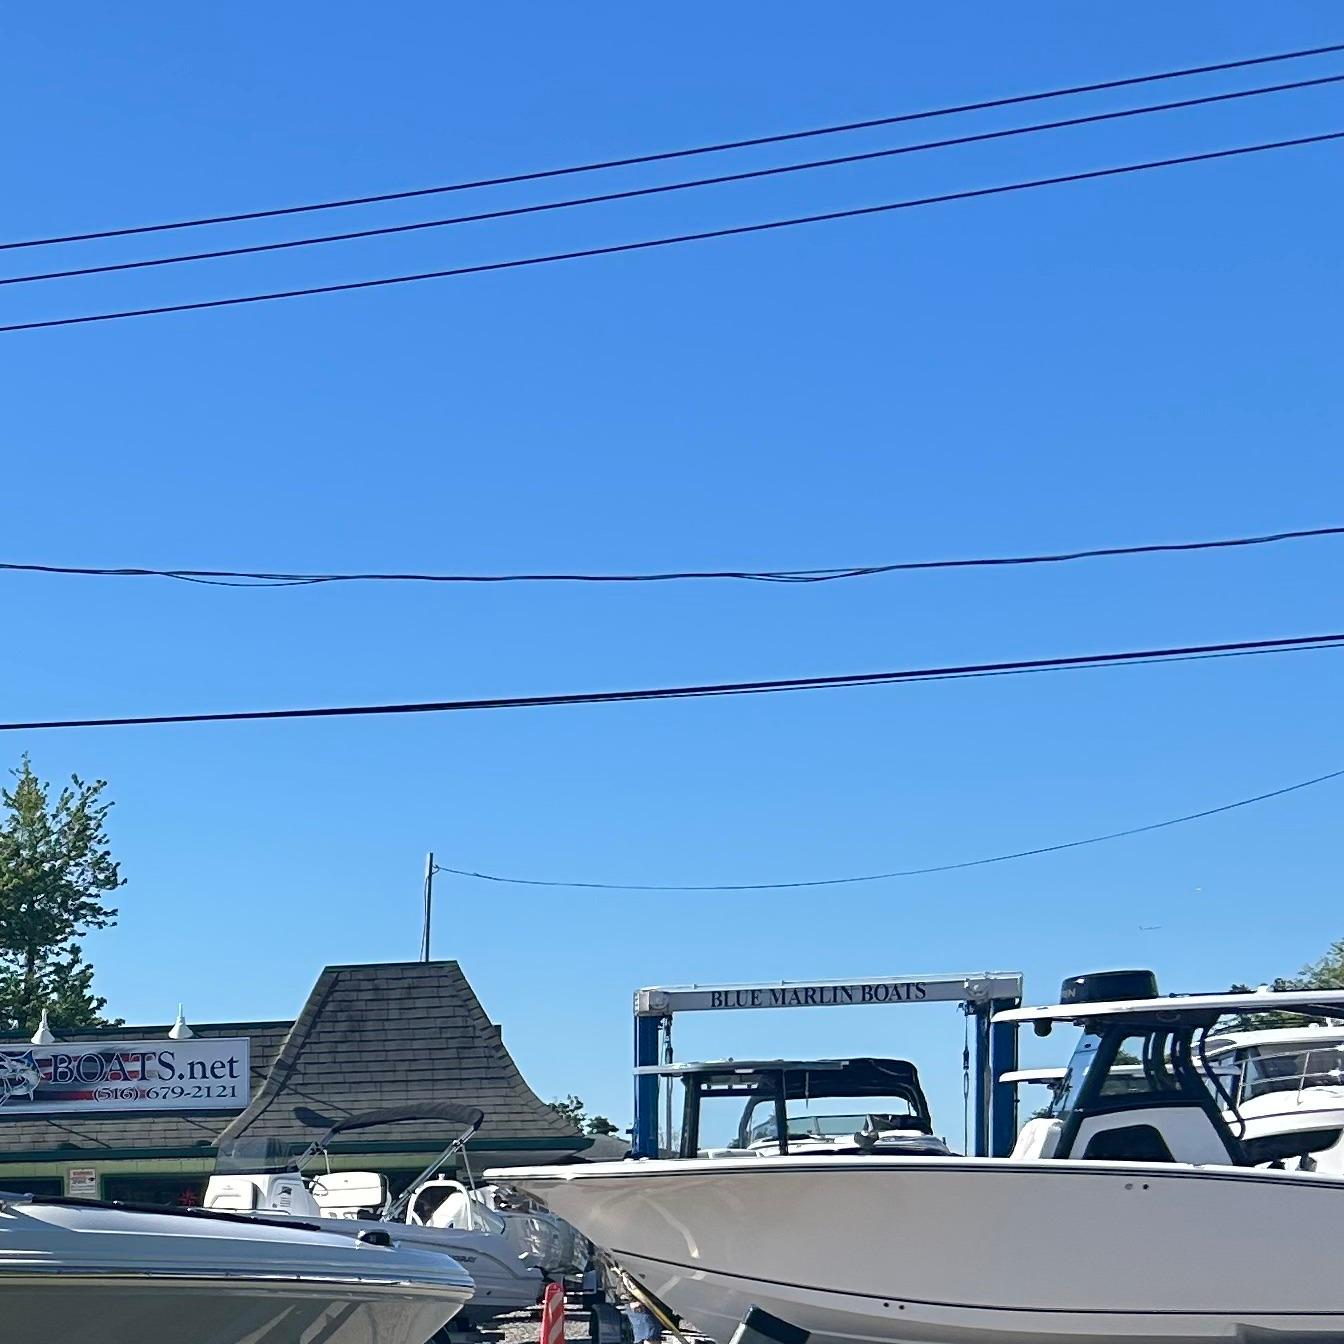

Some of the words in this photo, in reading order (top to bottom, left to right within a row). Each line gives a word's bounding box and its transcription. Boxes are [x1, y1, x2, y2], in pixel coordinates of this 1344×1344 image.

[711, 990, 762, 1008] BLUE
[768, 985, 854, 1005] MARLIN
[861, 981, 928, 1001] BOATS
[50, 1050, 240, 1084] BOATS.net
[92, 1087, 140, 1102] (516)
[146, 1085, 238, 1099] 679-2121
